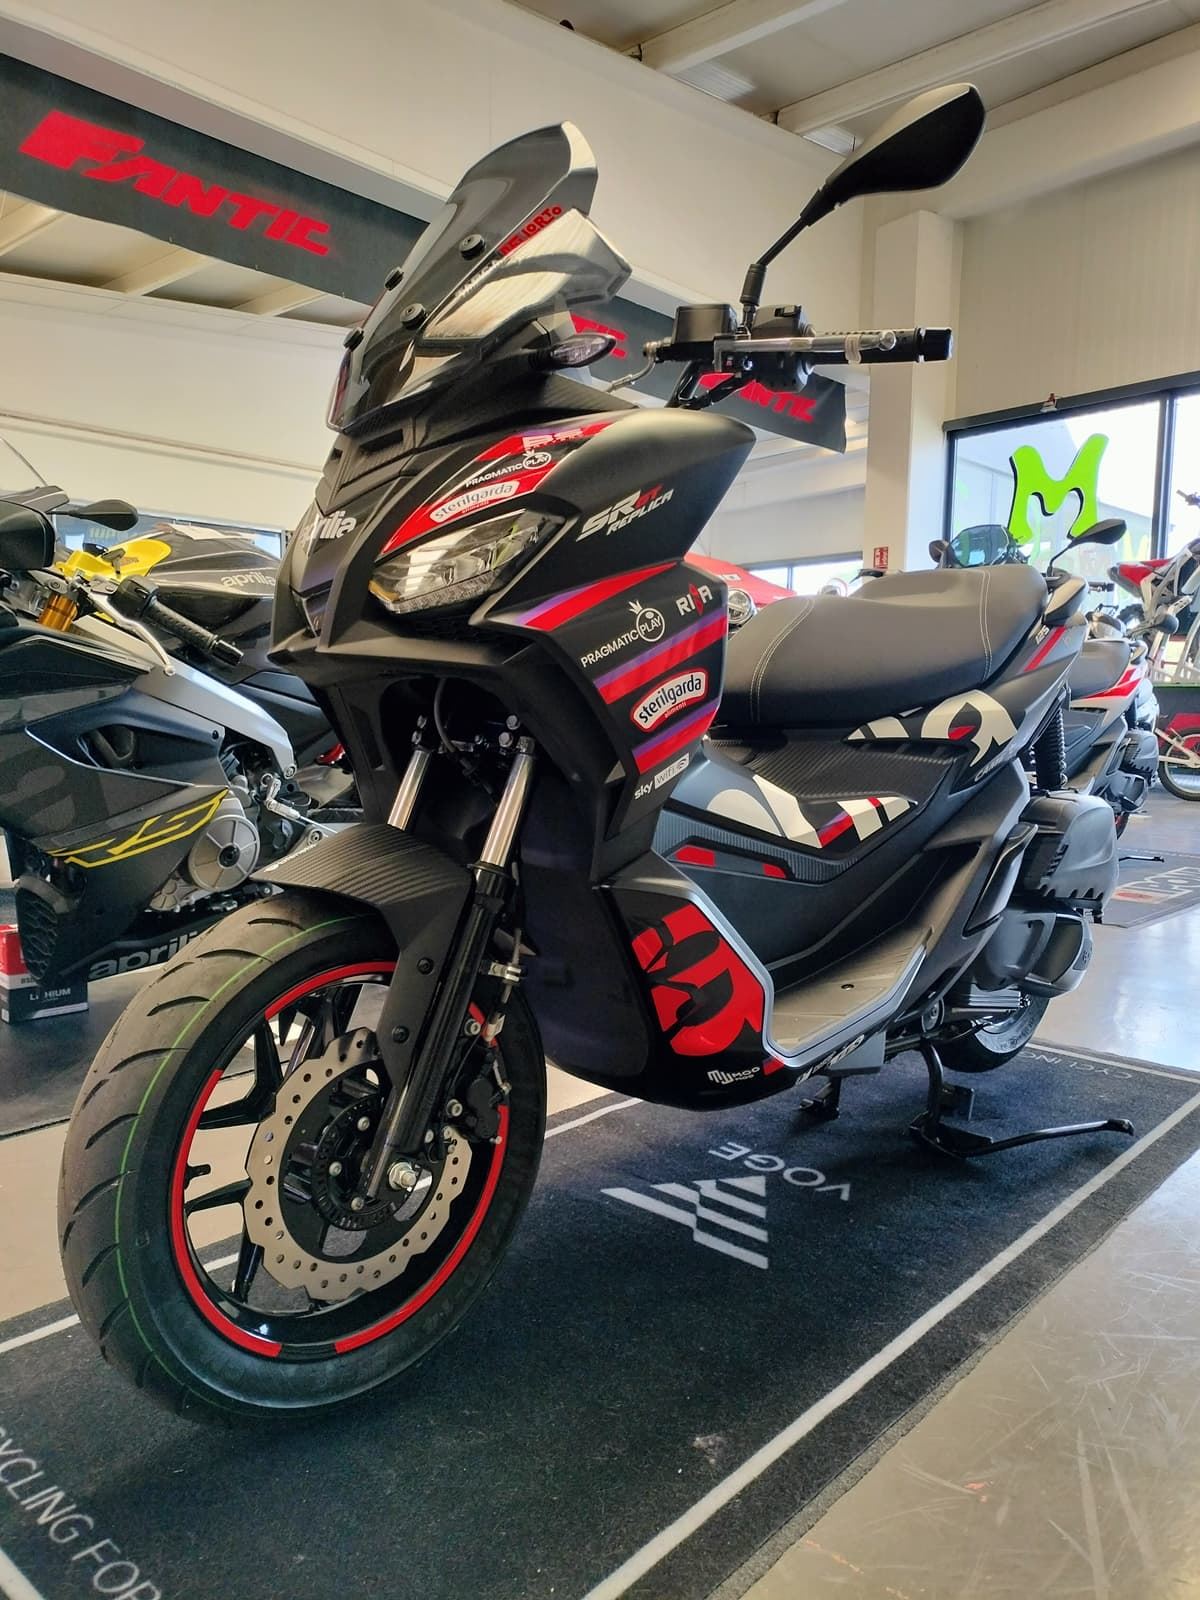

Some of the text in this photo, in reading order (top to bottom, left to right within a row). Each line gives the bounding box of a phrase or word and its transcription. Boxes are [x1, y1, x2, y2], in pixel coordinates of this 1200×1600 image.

[19, 109, 331, 256] FANTIC
[698, 372, 818, 423] NTIC
[465, 454, 549, 487] PRAGMATIC PLAY
[435, 482, 514, 521] sterilgarda
[606, 488, 674, 536] REPLICA
[220, 572, 276, 588] aprilia
[580, 616, 662, 668] PRAGMATIC PLAY
[638, 674, 702, 723] sterilgarda
[634, 781, 653, 800] sky
[88, 931, 199, 979] april
[29, 988, 71, 1001] LHIUM
[708, 1142, 850, 1201] VOGE
[0, 1427, 94, 1543] YCLING
